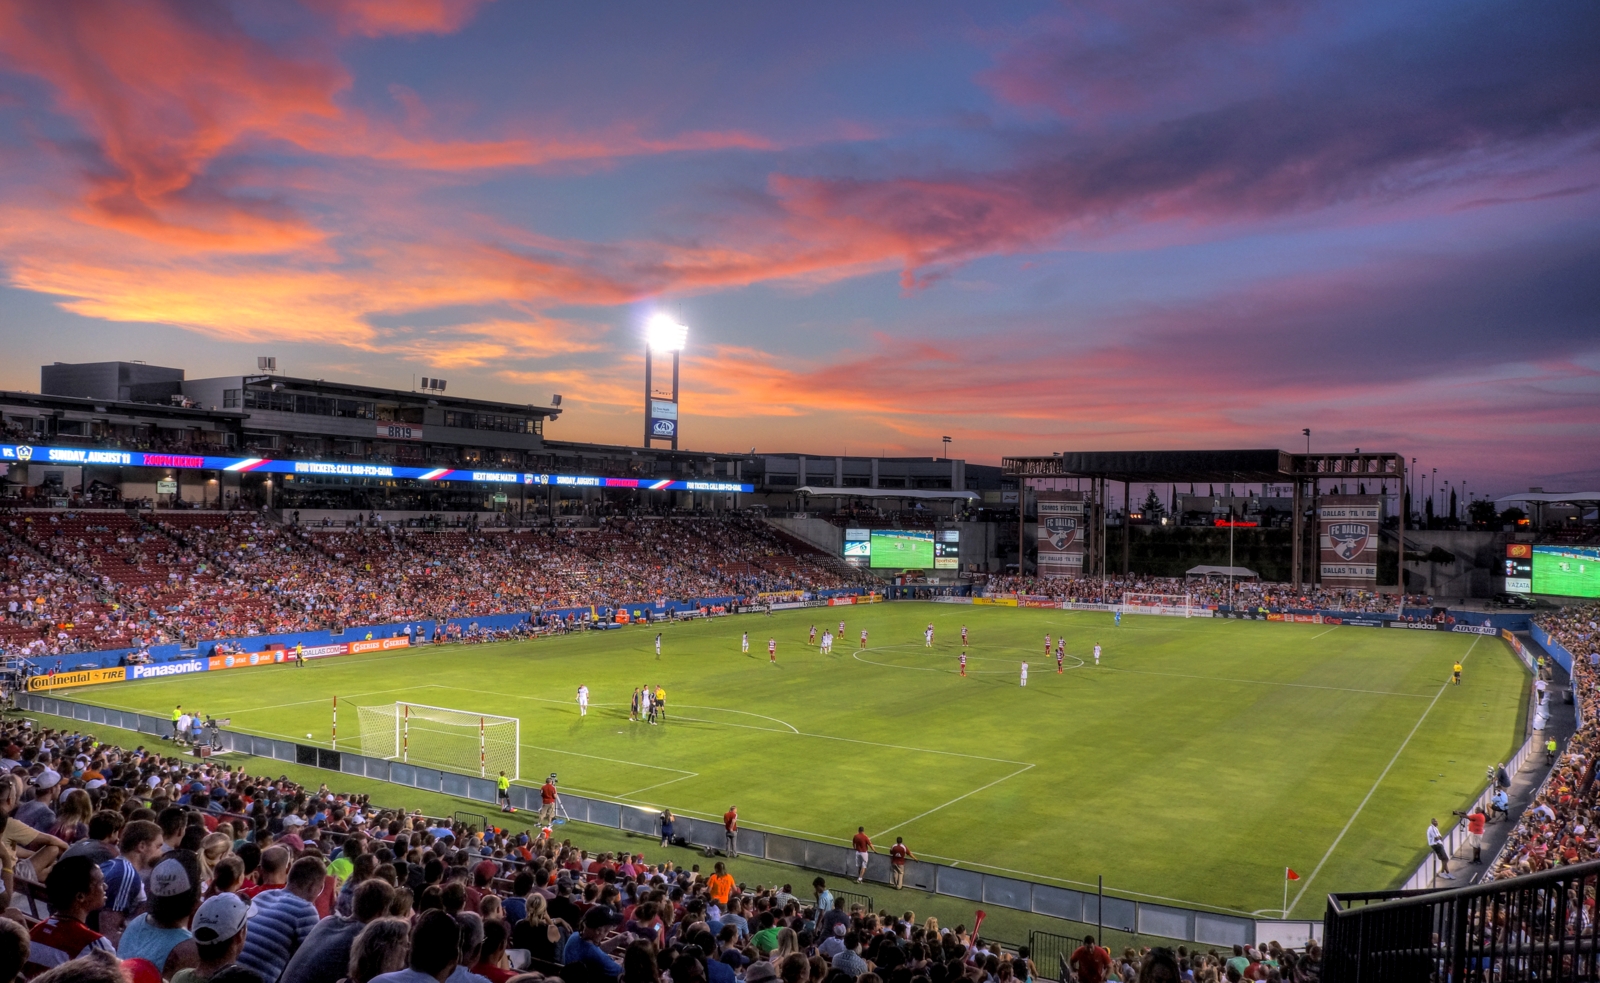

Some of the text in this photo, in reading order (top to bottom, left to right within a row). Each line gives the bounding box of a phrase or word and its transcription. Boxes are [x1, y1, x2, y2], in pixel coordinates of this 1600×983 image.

[388, 426, 412, 438] BR19
[88, 451, 120, 463] AUGUST
[121, 453, 131, 464] 11
[172, 456, 204, 468] KICKOFF
[295, 462, 309, 472] FOR
[337, 465, 352, 474] CALL
[472, 472, 517, 482] NEXT HOME MATCH
[1046, 518, 1074, 528] FC DALLAS
[1332, 524, 1366, 535] FC DALLAS
[1408, 622, 1437, 630] adidas
[1452, 624, 1497, 636] ADVOCARE
[134, 660, 202, 678] Panasonic
[30, 670, 124, 689] Continental TIRE
